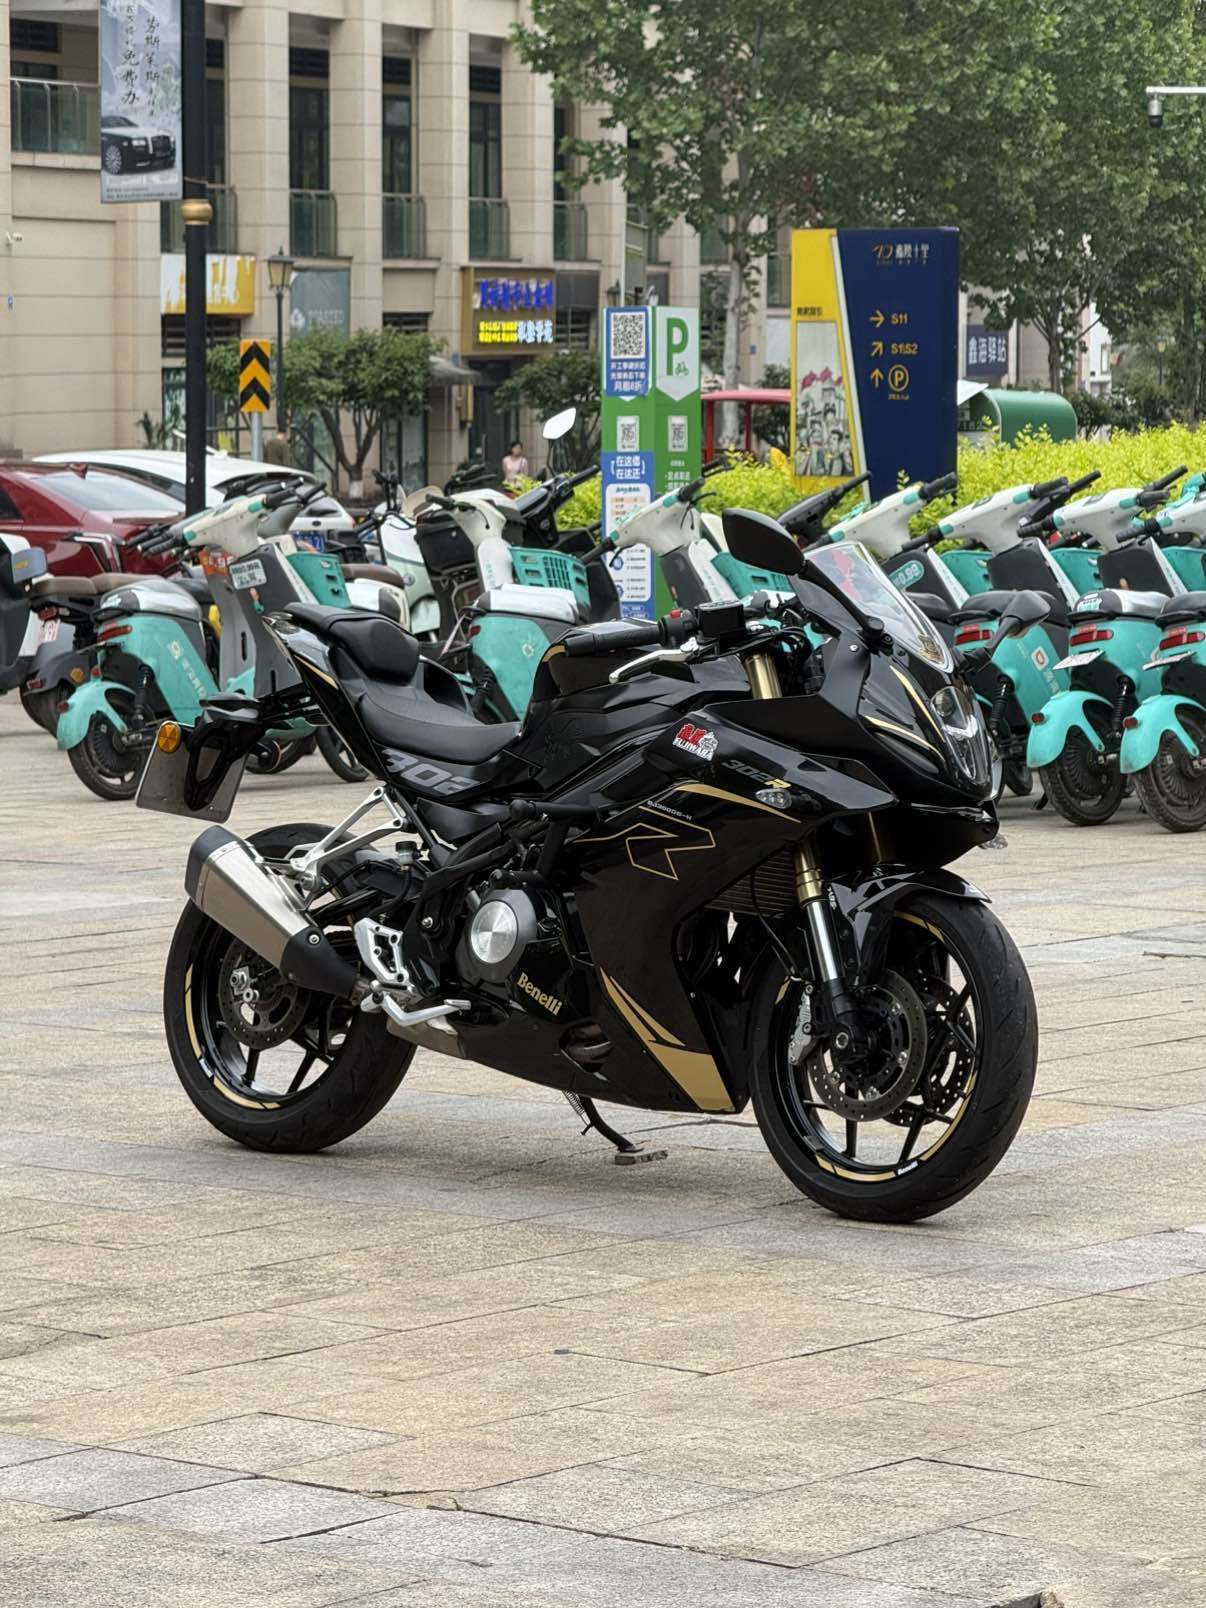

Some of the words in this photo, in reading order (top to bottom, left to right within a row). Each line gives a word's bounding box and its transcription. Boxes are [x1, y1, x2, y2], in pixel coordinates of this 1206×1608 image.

[890, 312, 908, 325] S11
[666, 317, 689, 376] P
[671, 737, 714, 761] FUJIWARA
[381, 748, 481, 796] 302
[516, 971, 563, 1016] Benelli
